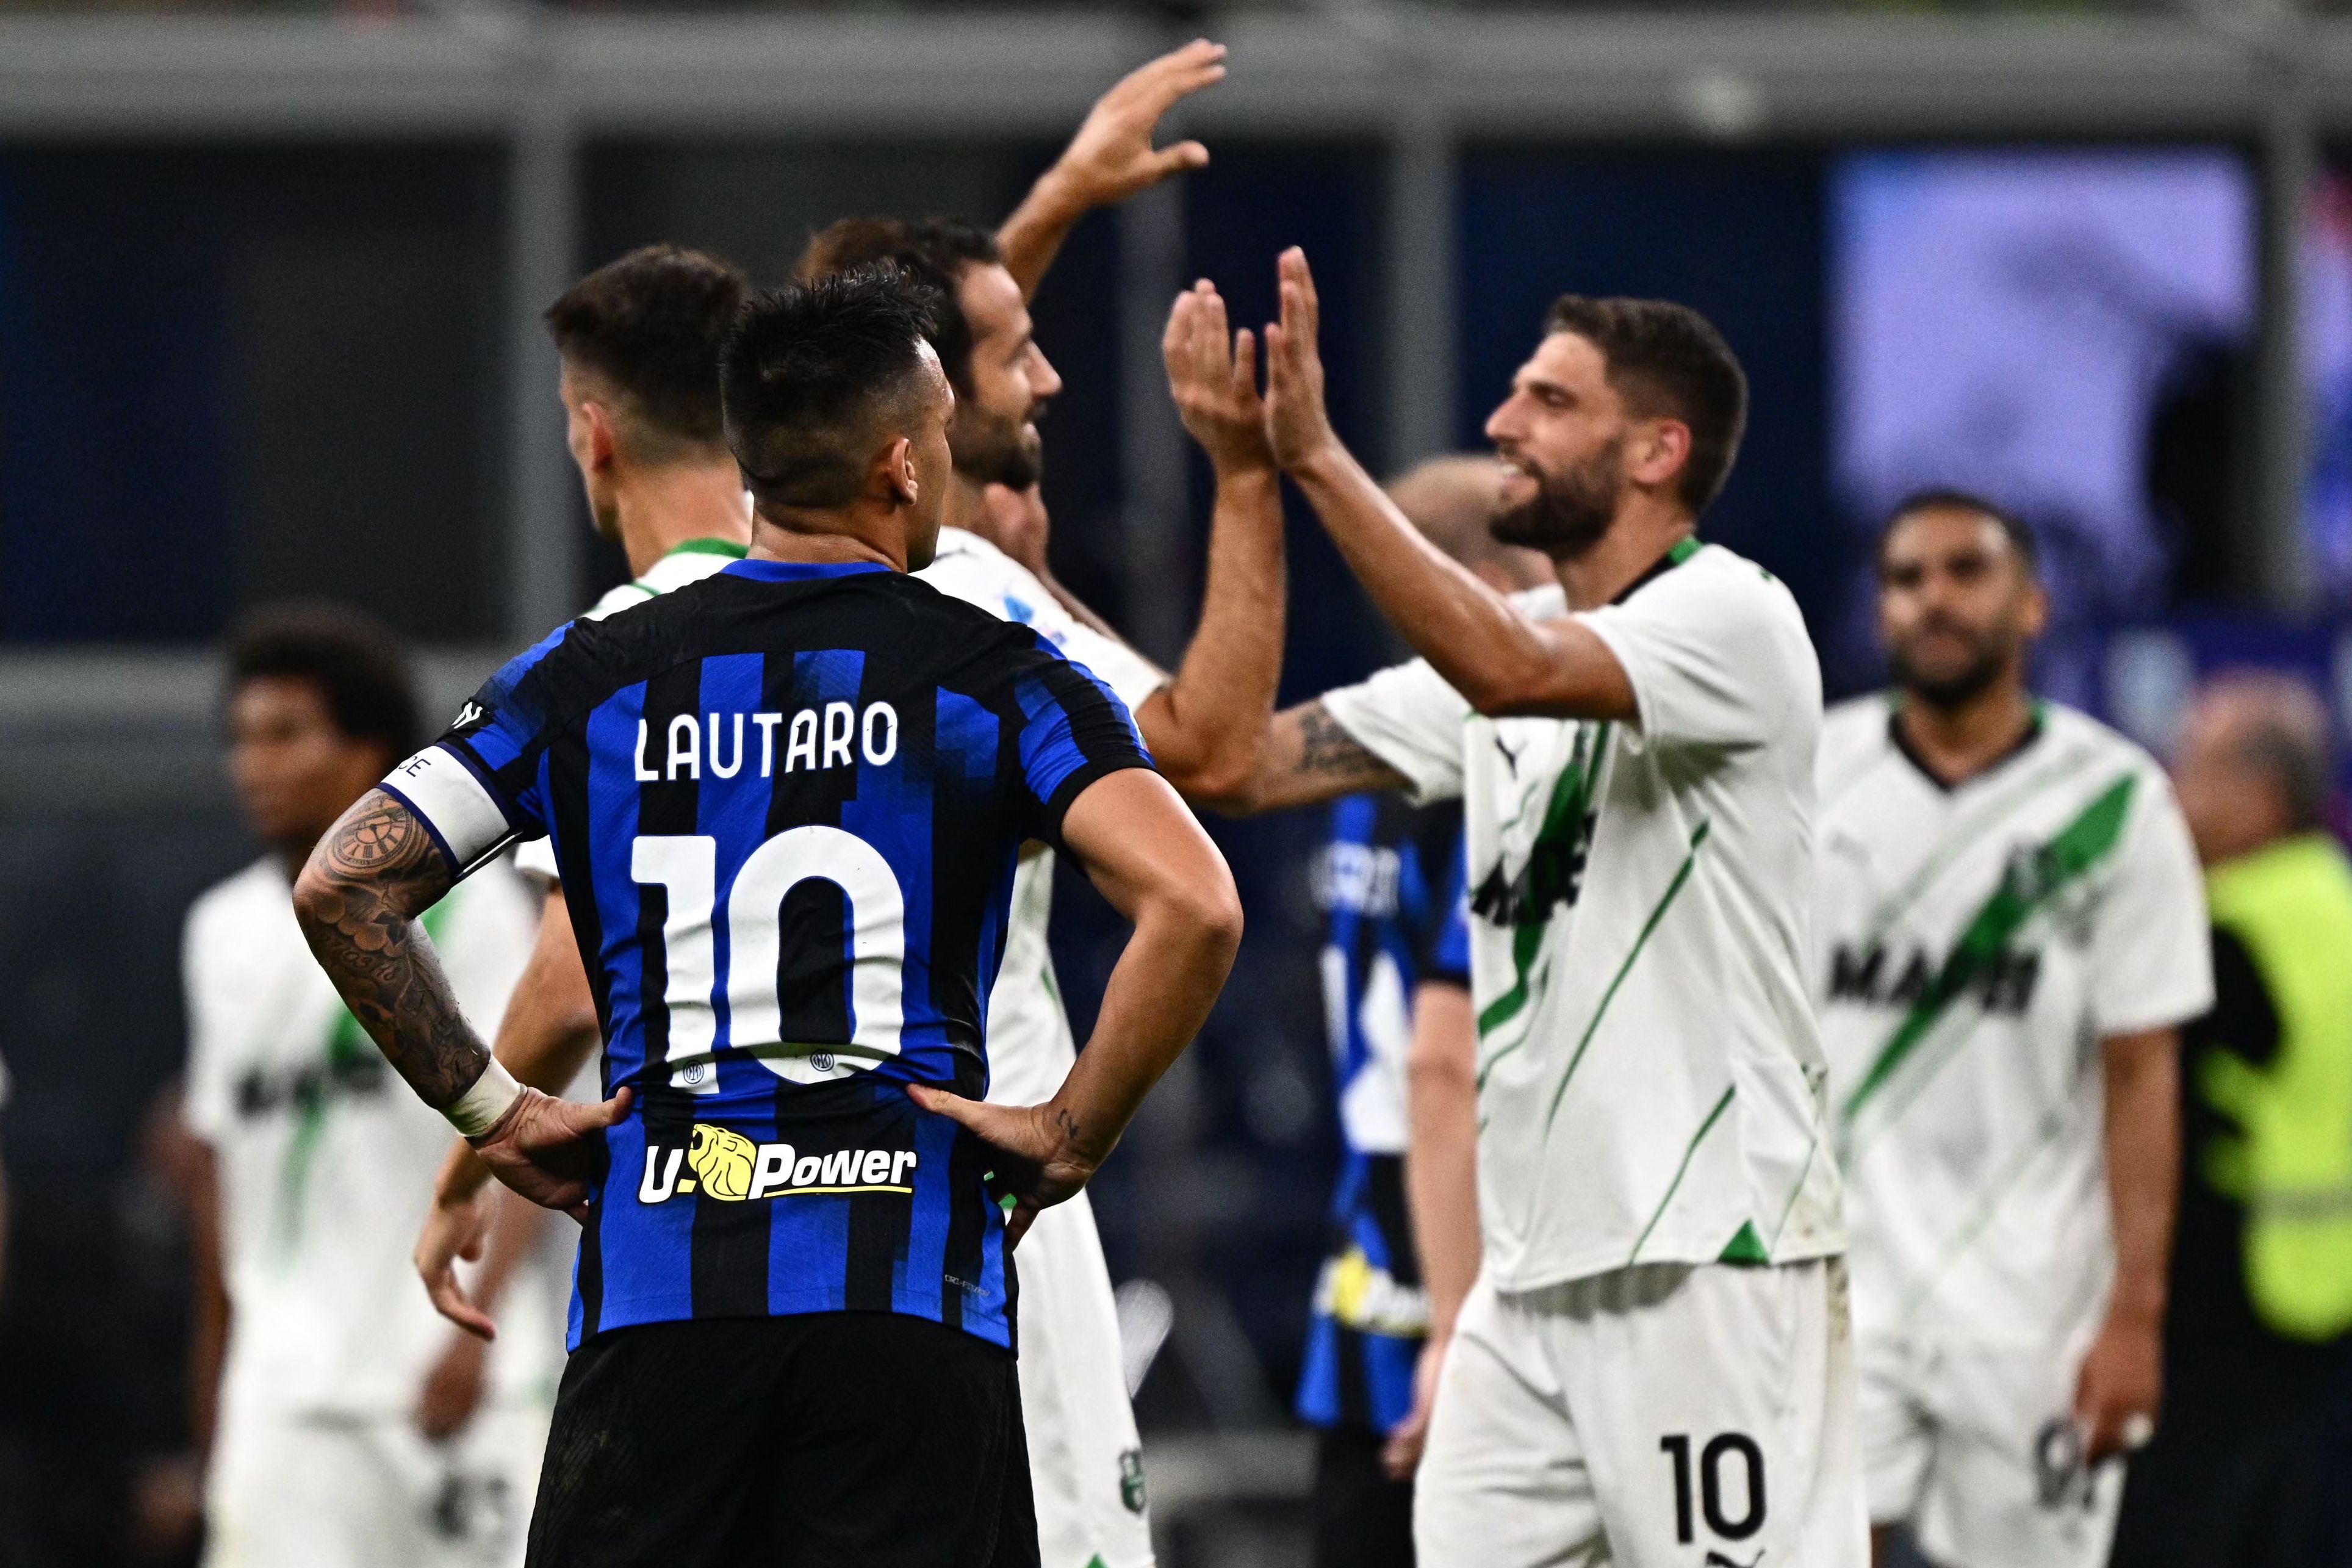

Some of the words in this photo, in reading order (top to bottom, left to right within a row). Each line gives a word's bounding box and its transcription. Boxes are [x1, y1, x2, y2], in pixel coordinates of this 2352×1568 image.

[635, 701, 897, 782] LAUTARO
[631, 825, 905, 1095] 10
[1660, 1433, 1766, 1544] 10
